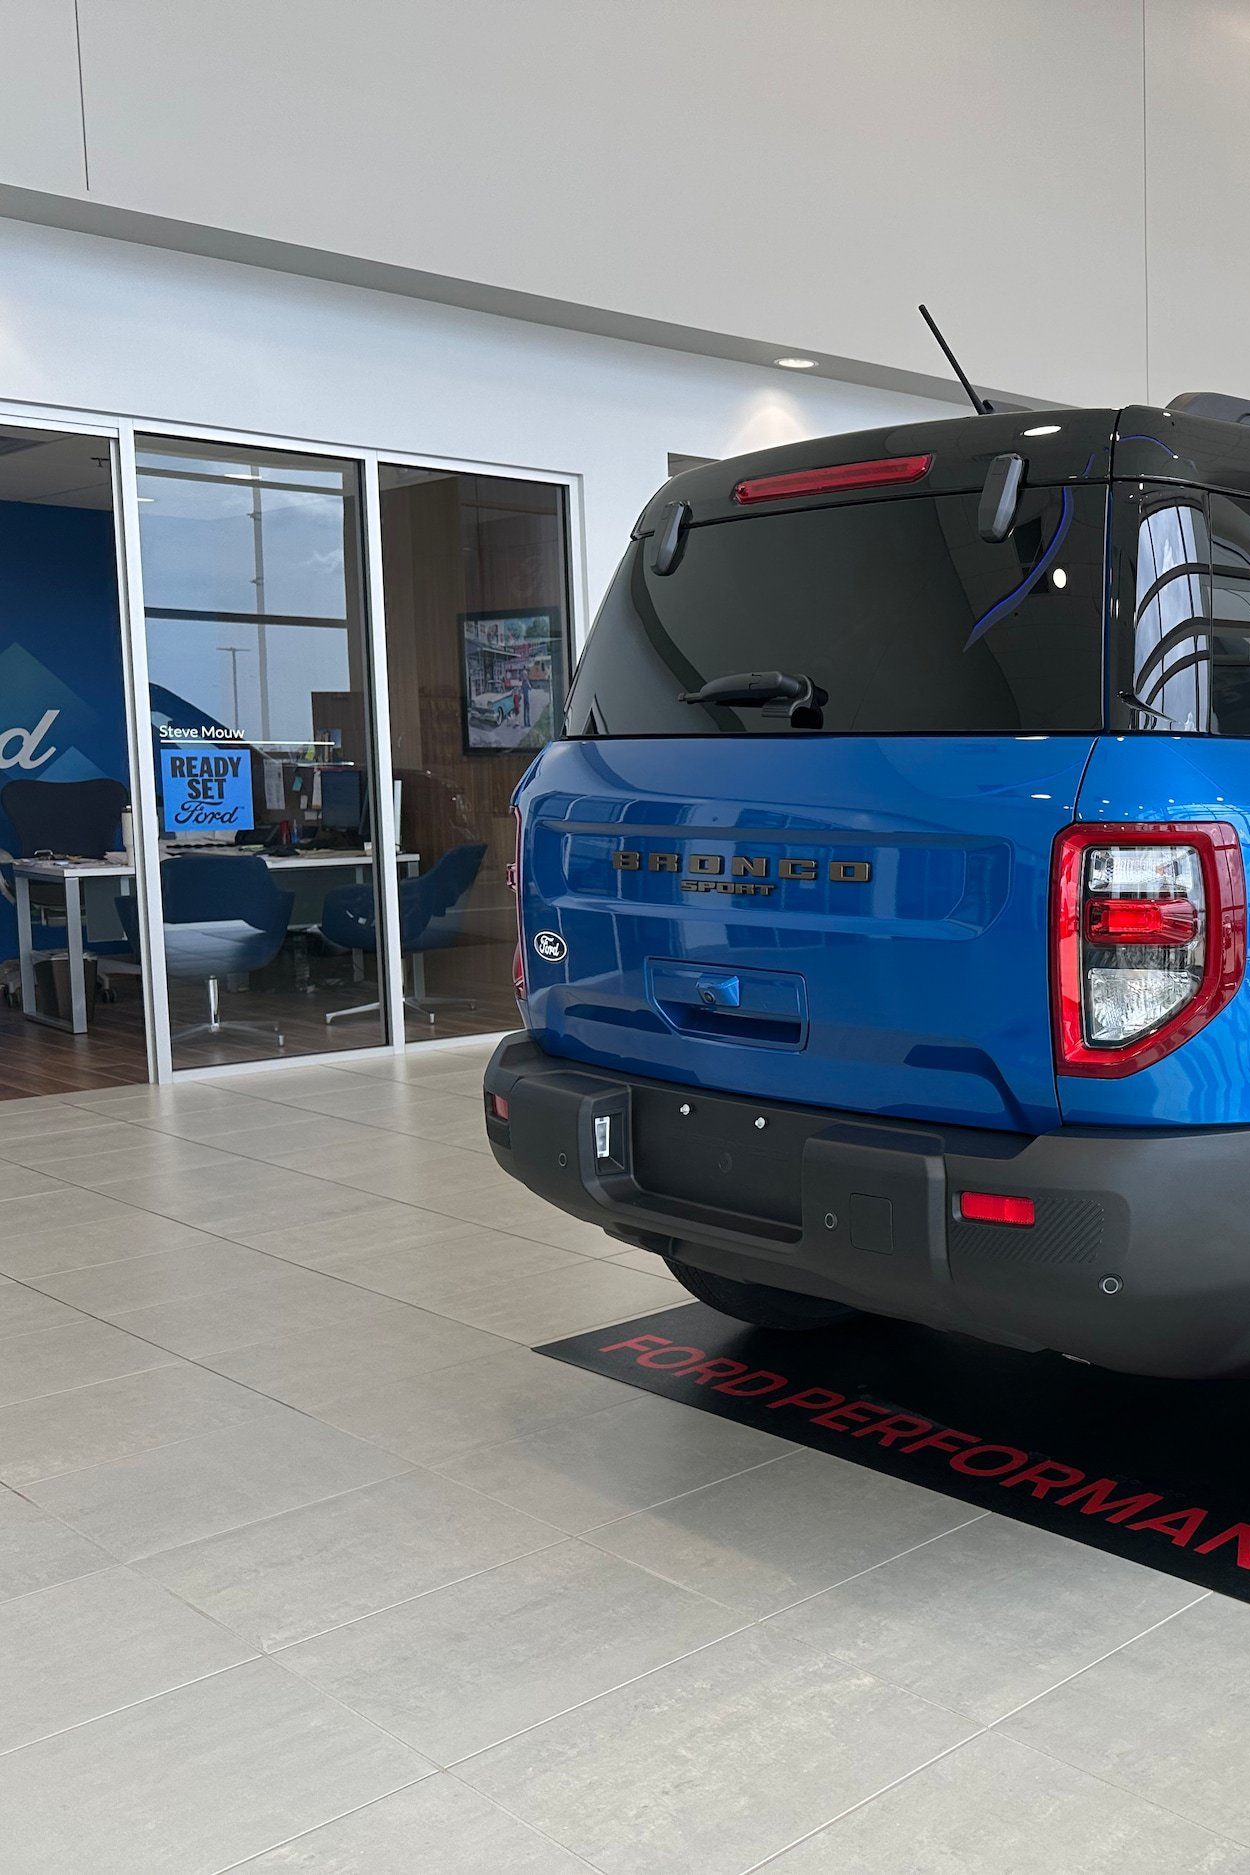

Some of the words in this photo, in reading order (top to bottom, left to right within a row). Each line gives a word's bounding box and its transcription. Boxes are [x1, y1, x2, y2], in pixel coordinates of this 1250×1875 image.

[159, 725, 198, 738] Steve
[201, 725, 245, 739] Mouw
[170, 756, 242, 778] READY
[187, 778, 227, 800] SET
[174, 800, 239, 825] Ford
[611, 850, 873, 882] BRONCO
[680, 879, 777, 897] SPORT
[539, 934, 561, 959] Ford
[598, 1334, 790, 1400] FORD
